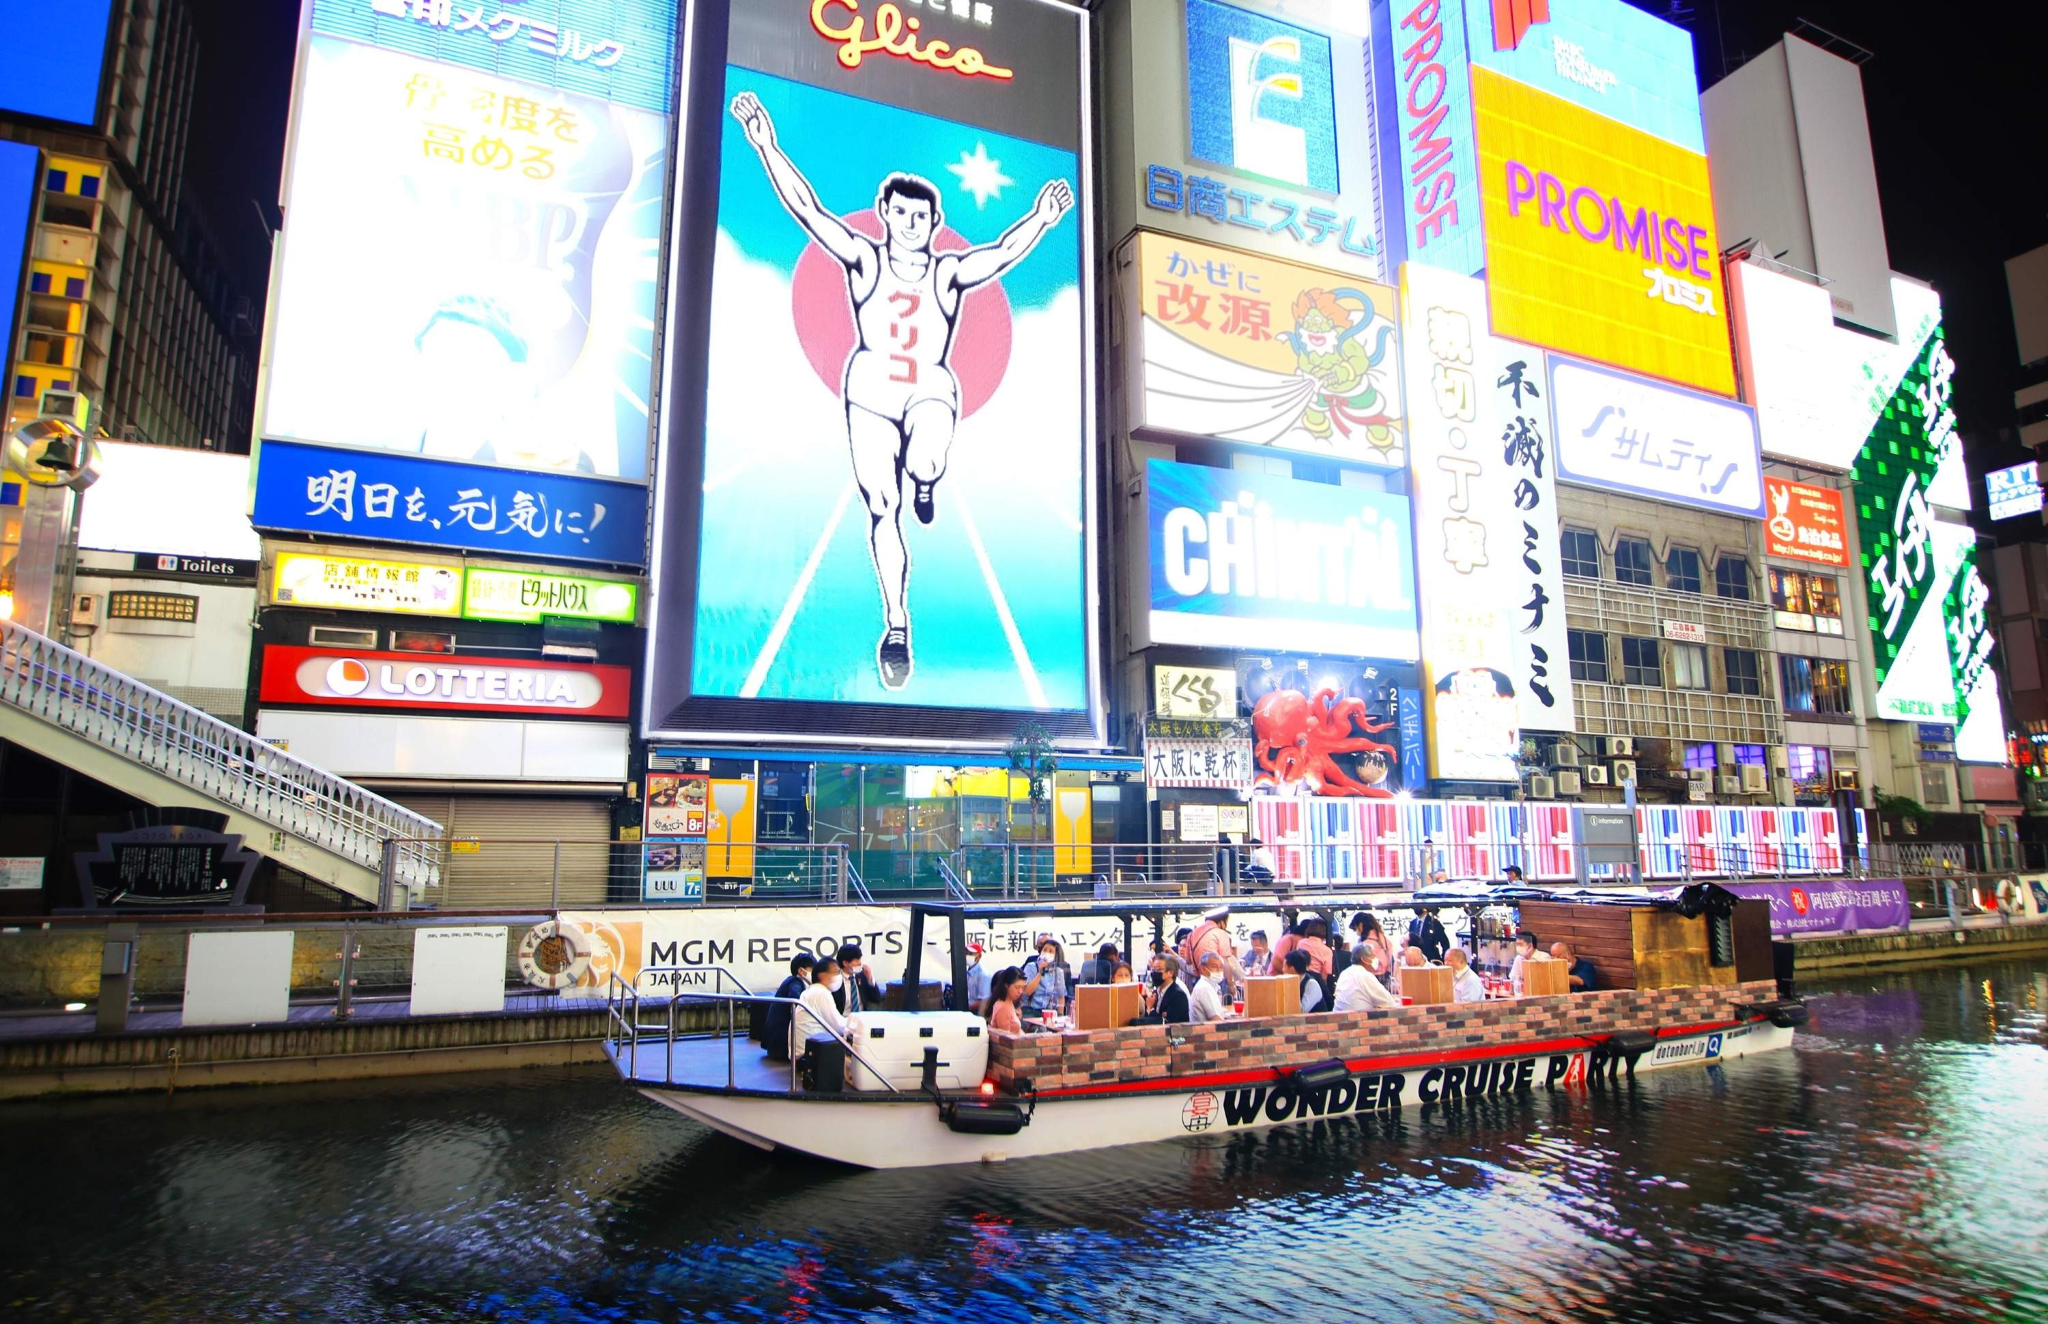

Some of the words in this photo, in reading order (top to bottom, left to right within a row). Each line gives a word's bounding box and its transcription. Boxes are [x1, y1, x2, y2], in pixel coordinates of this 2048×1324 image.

[810, 0, 1014, 80] Glico
[1399, 0, 1459, 250] PROMISE
[422, 121, 556, 181] 高める
[1147, 163, 1378, 257] 日商エステム
[1505, 159, 1713, 280] PROMISE
[1165, 250, 1262, 294] かぜに
[1643, 267, 1718, 317] プロミス
[1154, 279, 1273, 343] 改源
[887, 288, 922, 385] グリコ
[1496, 359, 1556, 708] 不滅のミナミ
[181, 558, 235, 575] Toilets
[380, 665, 577, 703] LOTTERIA
[1153, 746, 1238, 779] 大阪に乾杯
[1689, 782, 1705, 792] BAR
[688, 818, 703, 832] 8F
[686, 882, 701, 895] 7F
[650, 938, 735, 966] MGM
[649, 971, 707, 987] JAPAN
[1656, 1041, 1706, 1060] dotonbori.jp
[1223, 1072, 1406, 1127] WONDER
[1417, 1057, 1537, 1104] CRUISE
